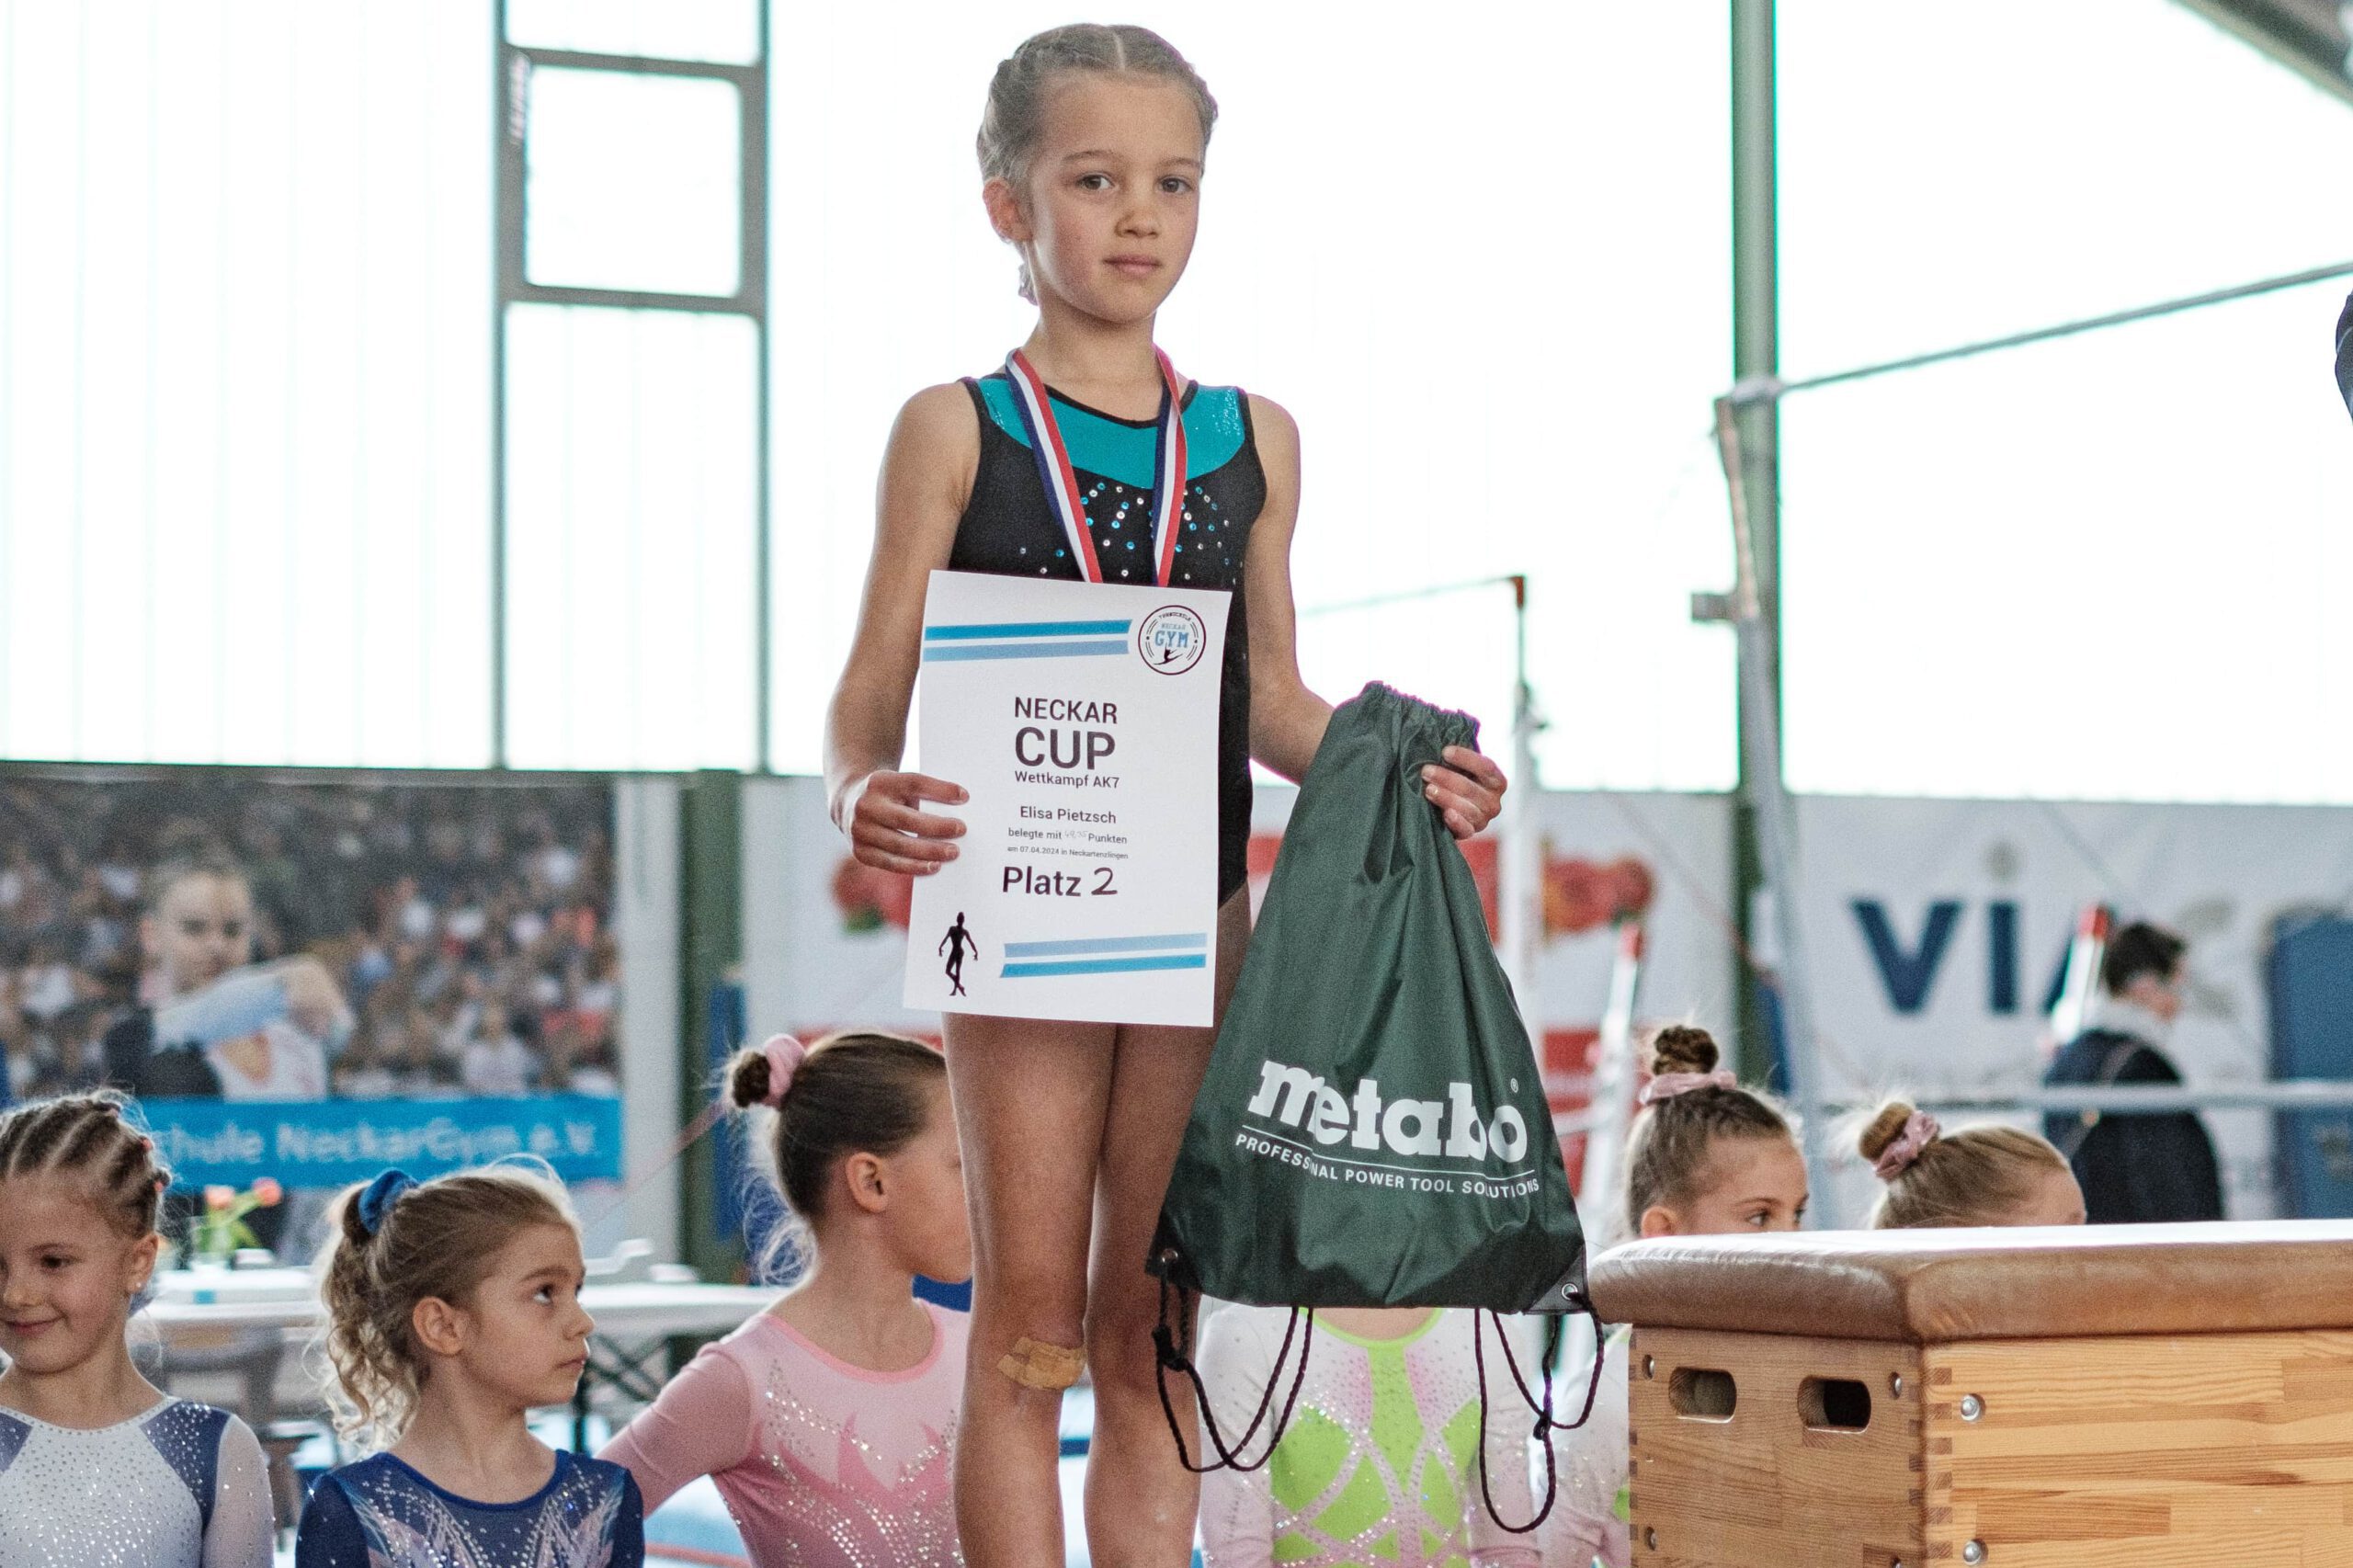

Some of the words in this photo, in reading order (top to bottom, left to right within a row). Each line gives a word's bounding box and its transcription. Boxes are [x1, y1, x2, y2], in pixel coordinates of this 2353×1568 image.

[1154, 630, 1188, 648] GYM
[1015, 696, 1118, 724] NECKAR
[1015, 726, 1116, 770] CUP
[1015, 770, 1088, 789] Wettkampf
[1093, 775, 1120, 789] AK7
[1020, 805, 1053, 820] Elisa
[1057, 808, 1117, 824] Pietzsch
[1008, 826, 1044, 840] belegte
[1047, 829, 1063, 840] mit
[1088, 833, 1128, 844] Punkten
[1019, 846, 1060, 855] 07.04.2024
[1069, 848, 1129, 860] Neckartenzlingen
[1003, 866, 1082, 897] Platz
[1091, 867, 1119, 895] 2
[1247, 1060, 1528, 1163] metabo
[1345, 1168, 1404, 1189] POWER
[1410, 1177, 1454, 1193] TOOL
[1461, 1177, 1540, 1199] SOLUTIONS
